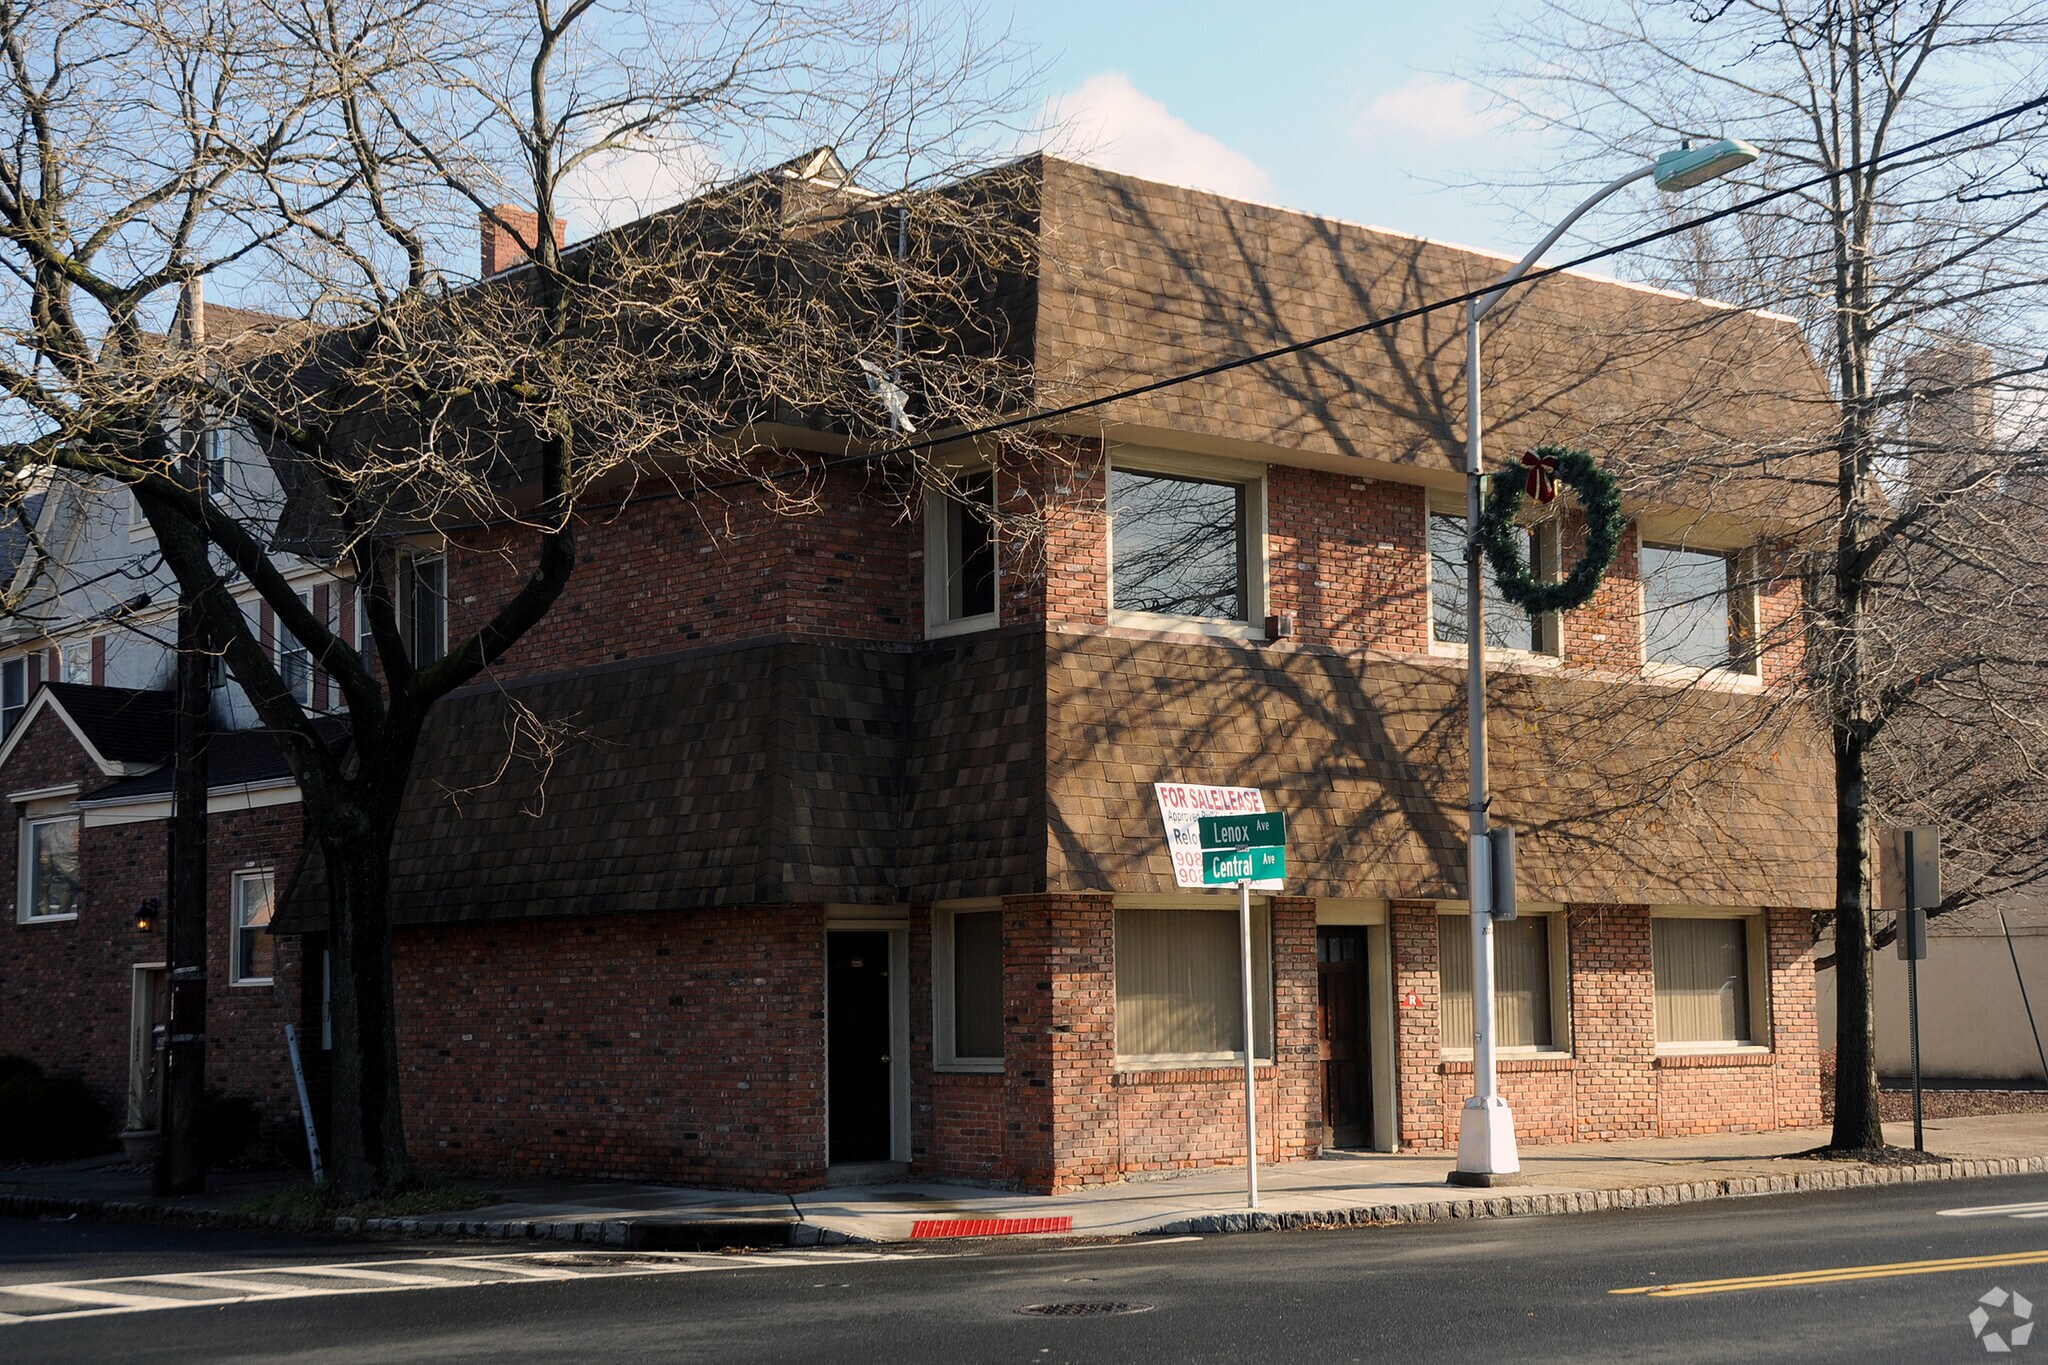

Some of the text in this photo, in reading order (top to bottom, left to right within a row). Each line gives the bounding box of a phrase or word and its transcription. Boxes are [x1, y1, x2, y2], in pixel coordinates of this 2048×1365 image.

[1160, 787, 1188, 808] FOR
[1213, 819, 1270, 843] Lenox Ave
[1213, 852, 1276, 878] Central Ave
[1409, 994, 1417, 1005] R
